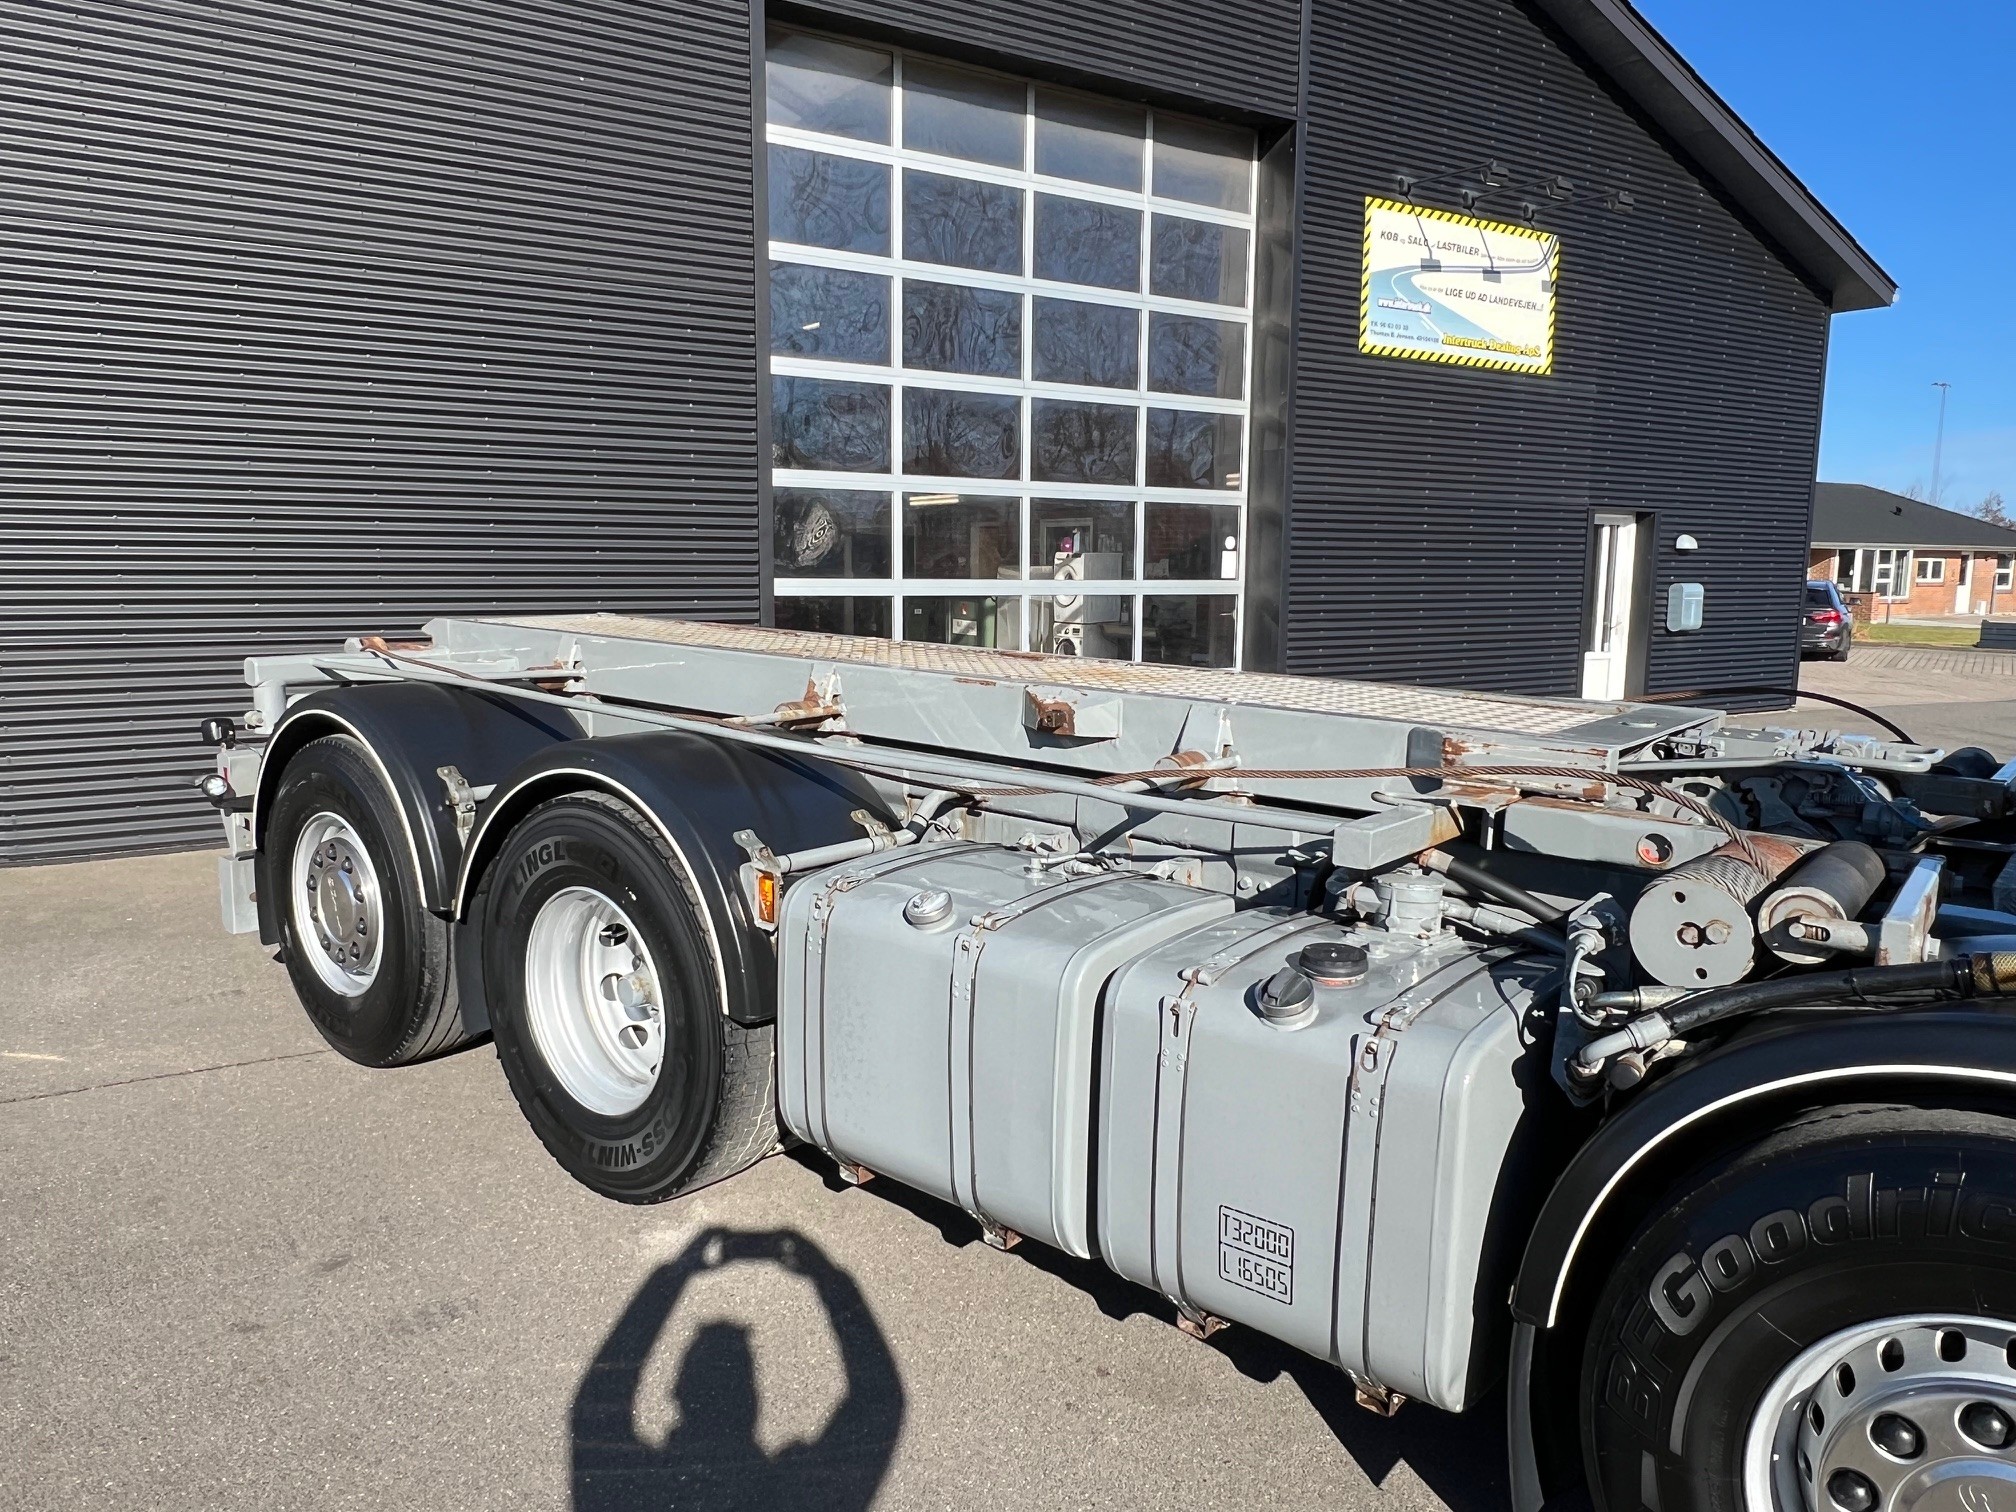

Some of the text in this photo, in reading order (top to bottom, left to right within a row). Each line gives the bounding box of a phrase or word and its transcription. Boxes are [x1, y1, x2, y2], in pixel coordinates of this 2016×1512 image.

[1380, 231, 1399, 242] KØB
[1436, 242, 1480, 256] LASTBILER
[1445, 287, 1463, 299] LIGE
[1465, 289, 1475, 300] UD
[1477, 292, 1488, 302] AD
[1441, 332, 1488, 349] Intertruck
[1488, 338, 1522, 356] Dealing
